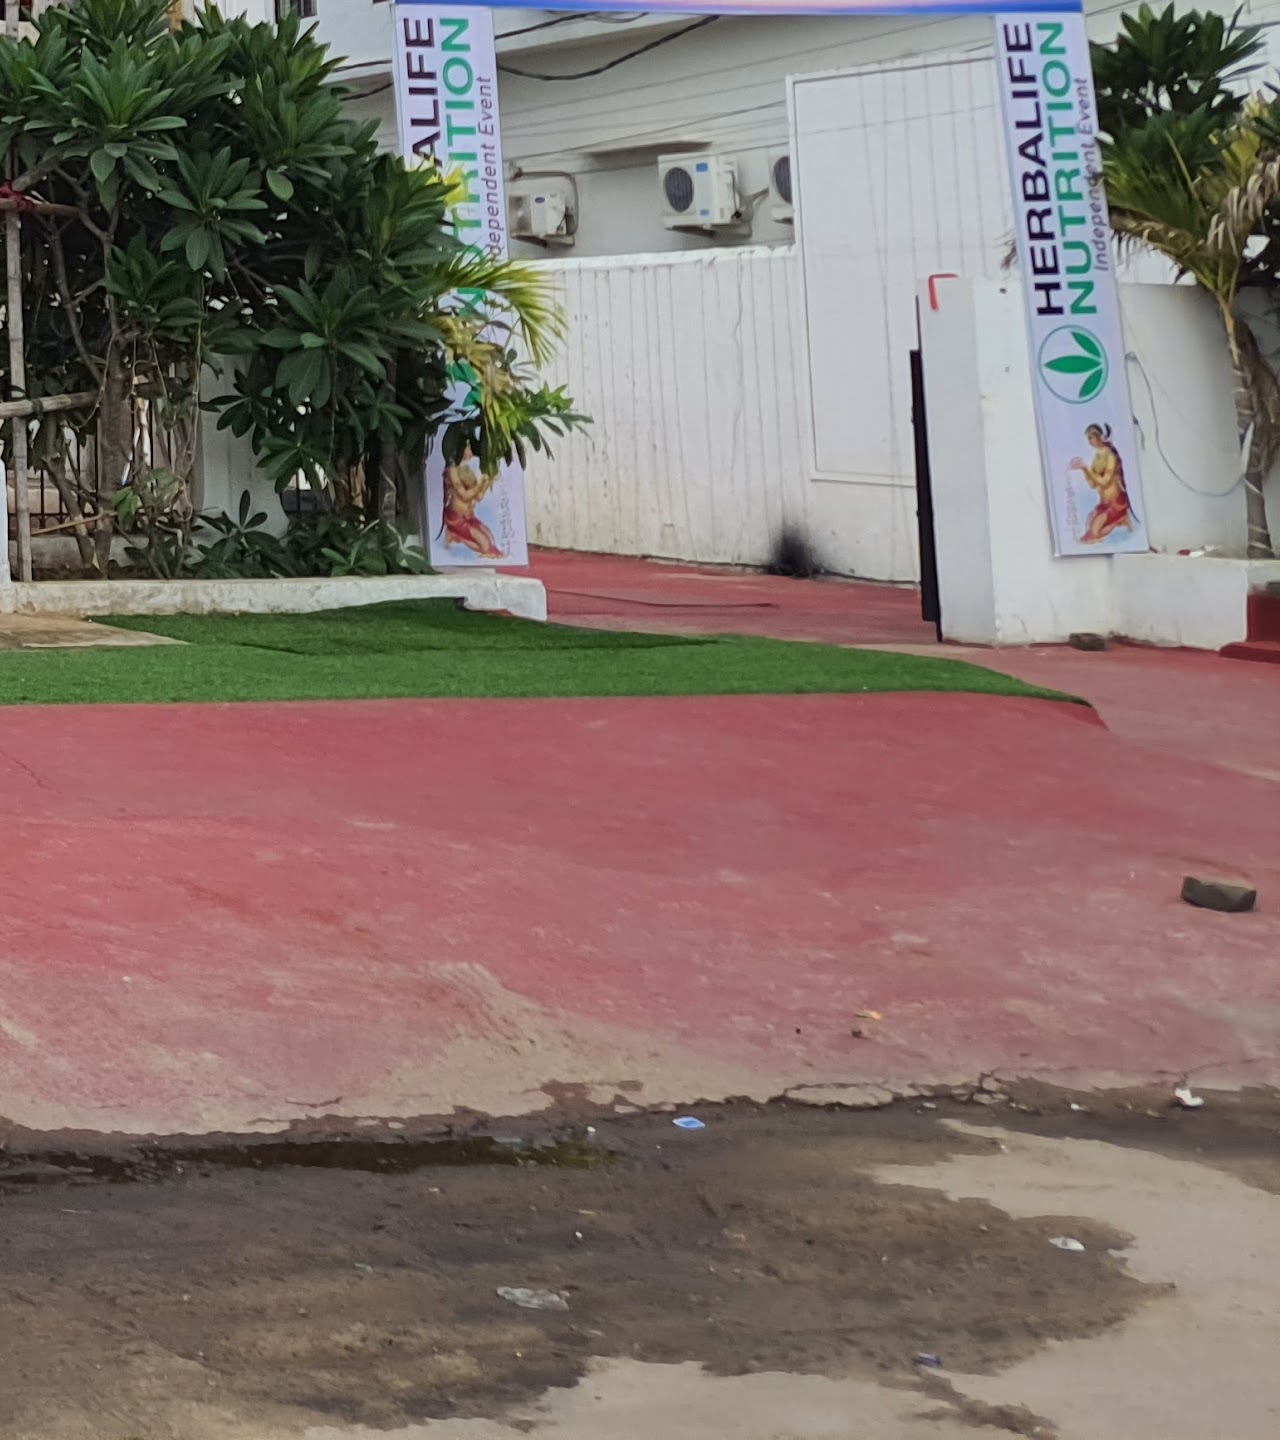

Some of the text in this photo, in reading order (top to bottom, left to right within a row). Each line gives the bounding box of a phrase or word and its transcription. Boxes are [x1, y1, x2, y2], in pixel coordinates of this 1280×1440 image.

[403, 17, 443, 168] ALIFE
[475, 76, 504, 259] dependent Event
[1003, 22, 1064, 316] HERBALIFE
[1036, 21, 1097, 315] NUTRITION
[1073, 76, 1108, 272] Independent Event
